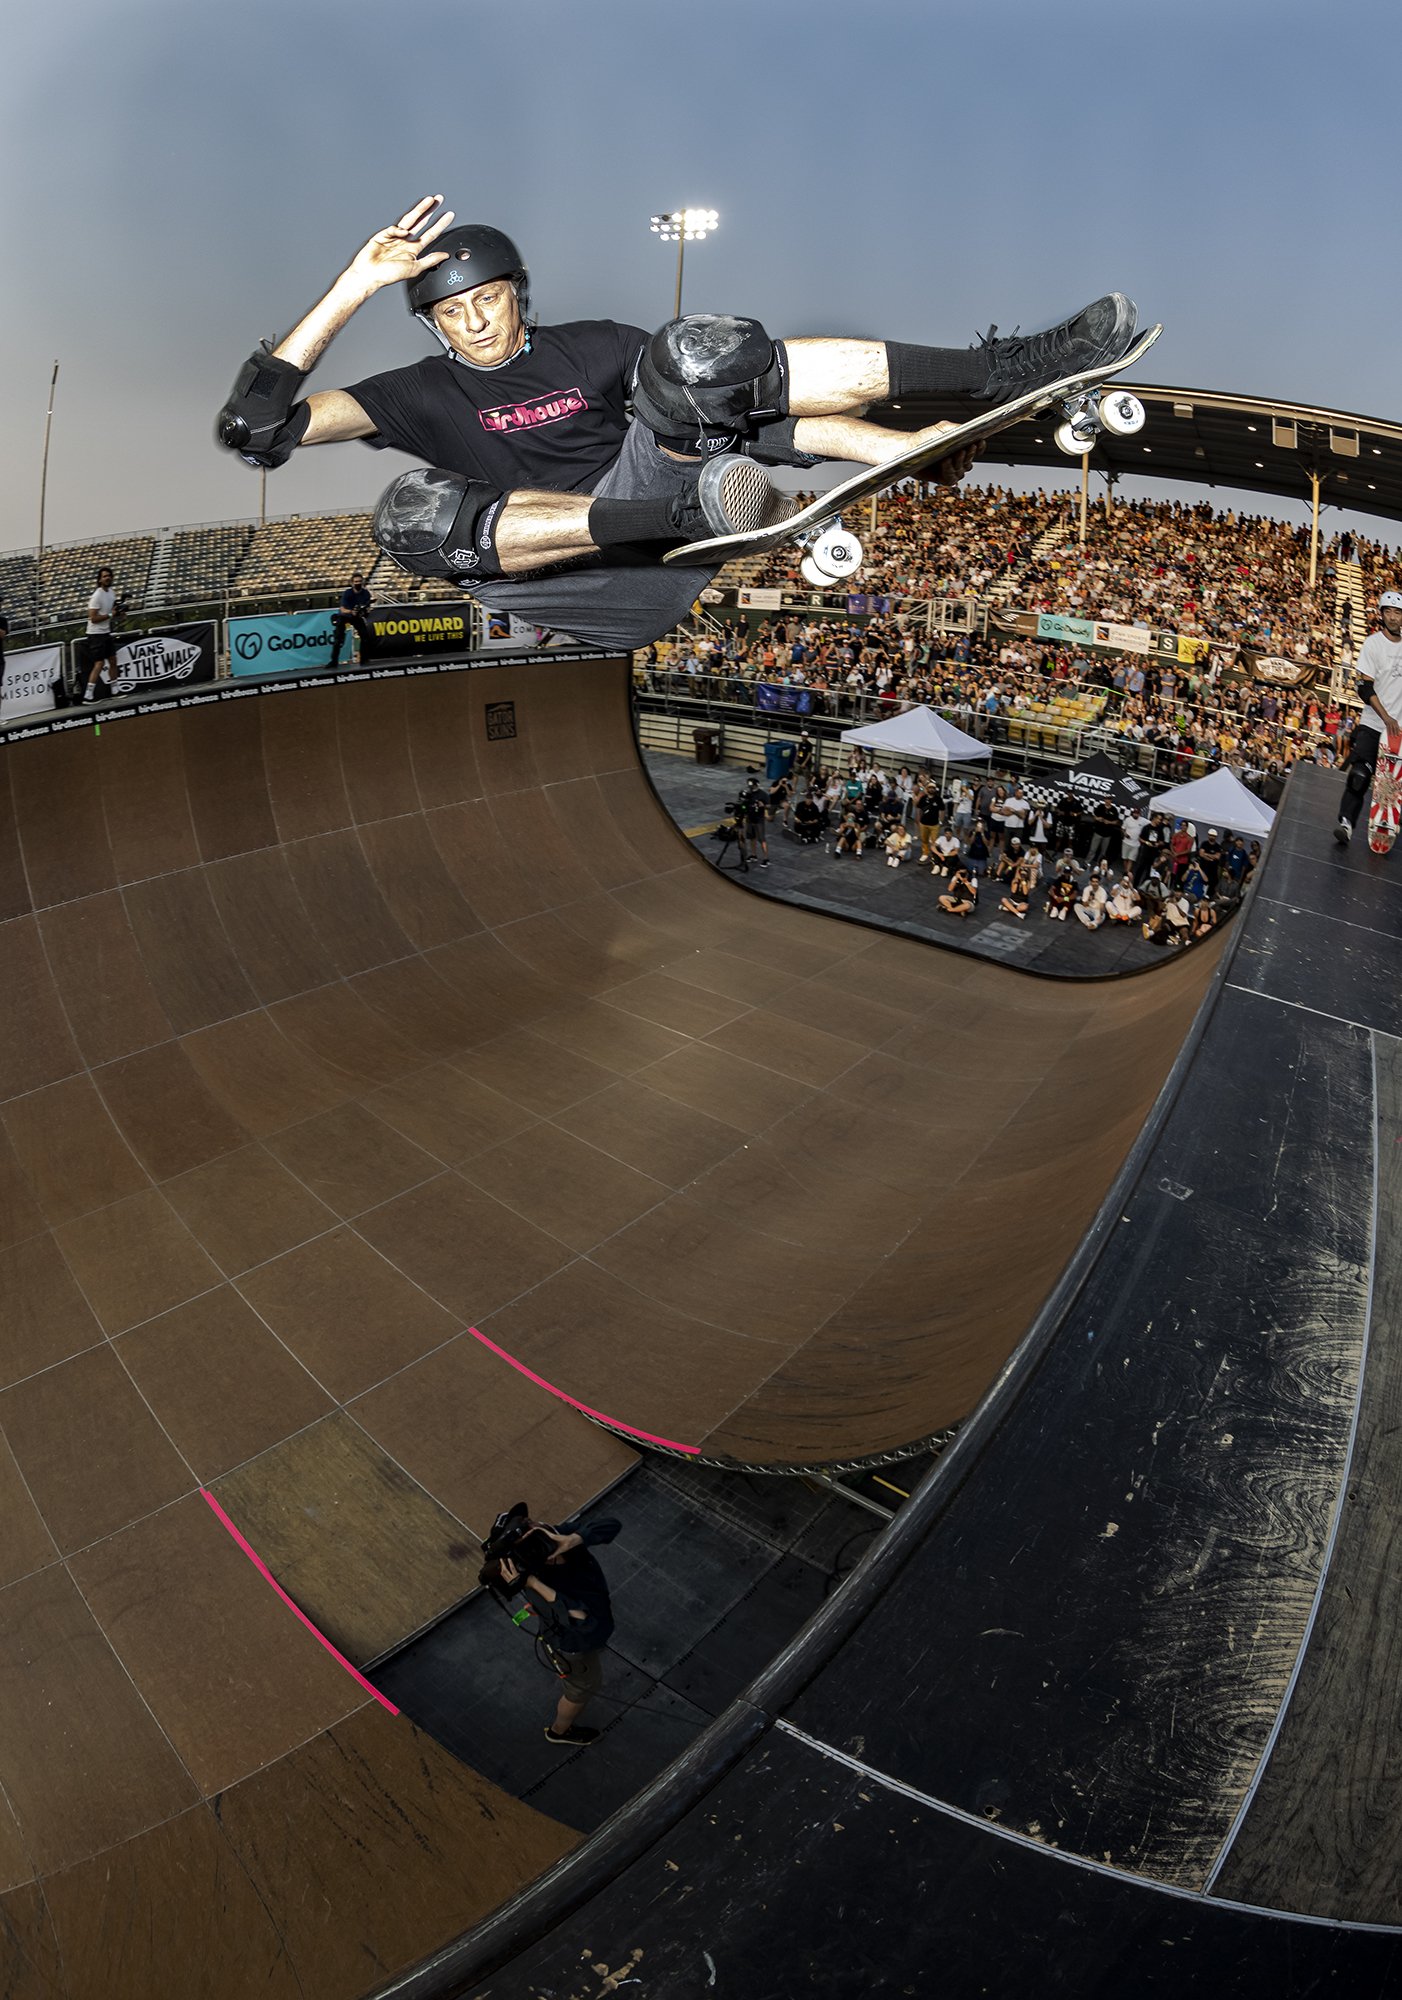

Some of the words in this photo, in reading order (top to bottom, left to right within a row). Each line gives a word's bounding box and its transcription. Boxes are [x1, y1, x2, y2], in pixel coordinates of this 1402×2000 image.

[419, 592, 427, 601] P
[811, 594, 821, 605] R
[373, 616, 464, 637] WOODWARD
[267, 629, 341, 652] GoDadd
[414, 634, 426, 643] WE
[428, 633, 445, 642] LIVE
[447, 631, 464, 640] THIS
[1163, 637, 1174, 650] S
[127, 642, 165, 660] VANS
[7, 667, 55, 686] SPORTS
[134, 656, 161, 678] THE
[8, 725, 49, 742] birdhouse
[52, 716, 93, 731] birdhouse
[96, 708, 136, 722] birdhouse
[138, 700, 178, 714] birdhouse
[180, 693, 220, 707] birdhouse
[1068, 769, 1115, 792] VANS
